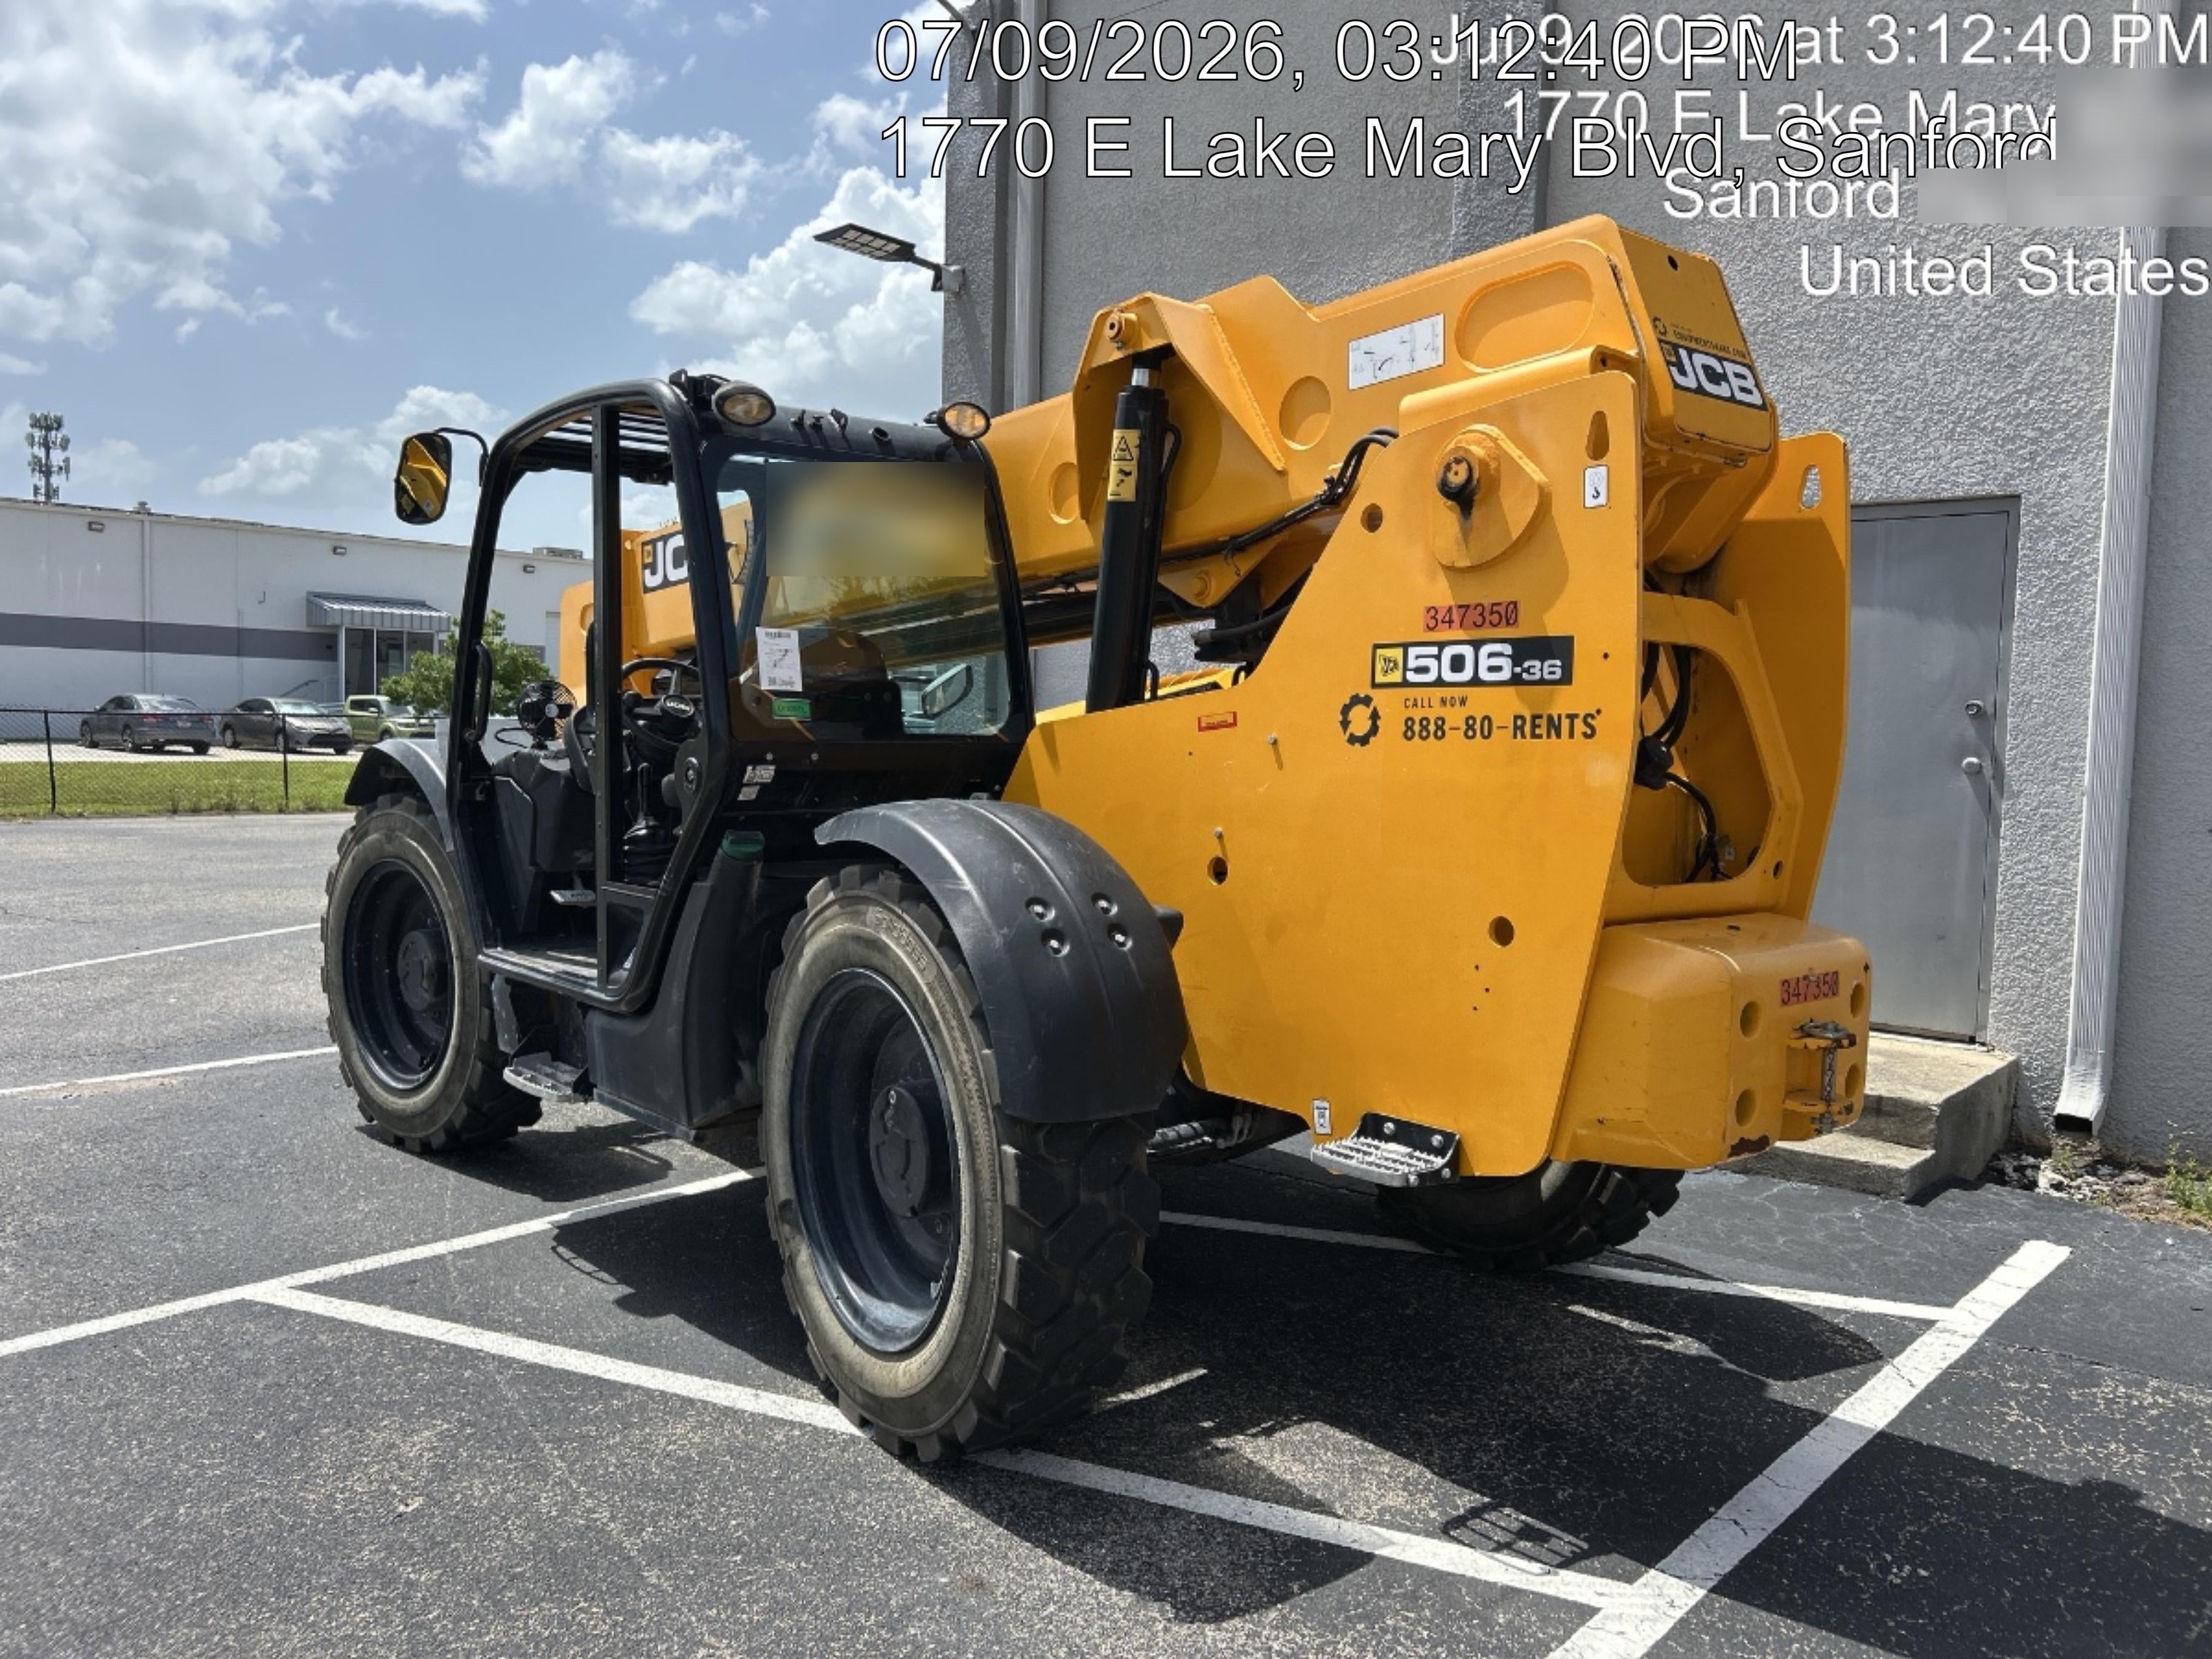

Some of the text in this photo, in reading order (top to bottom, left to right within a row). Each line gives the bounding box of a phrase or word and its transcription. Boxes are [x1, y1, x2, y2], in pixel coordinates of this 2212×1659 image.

[1669, 347, 1763, 406] JCB
[644, 534, 689, 587] JC
[1426, 601, 1518, 631] 347350
[1406, 643, 1563, 683] 506-36
[1404, 696, 1469, 708] CALL NOW
